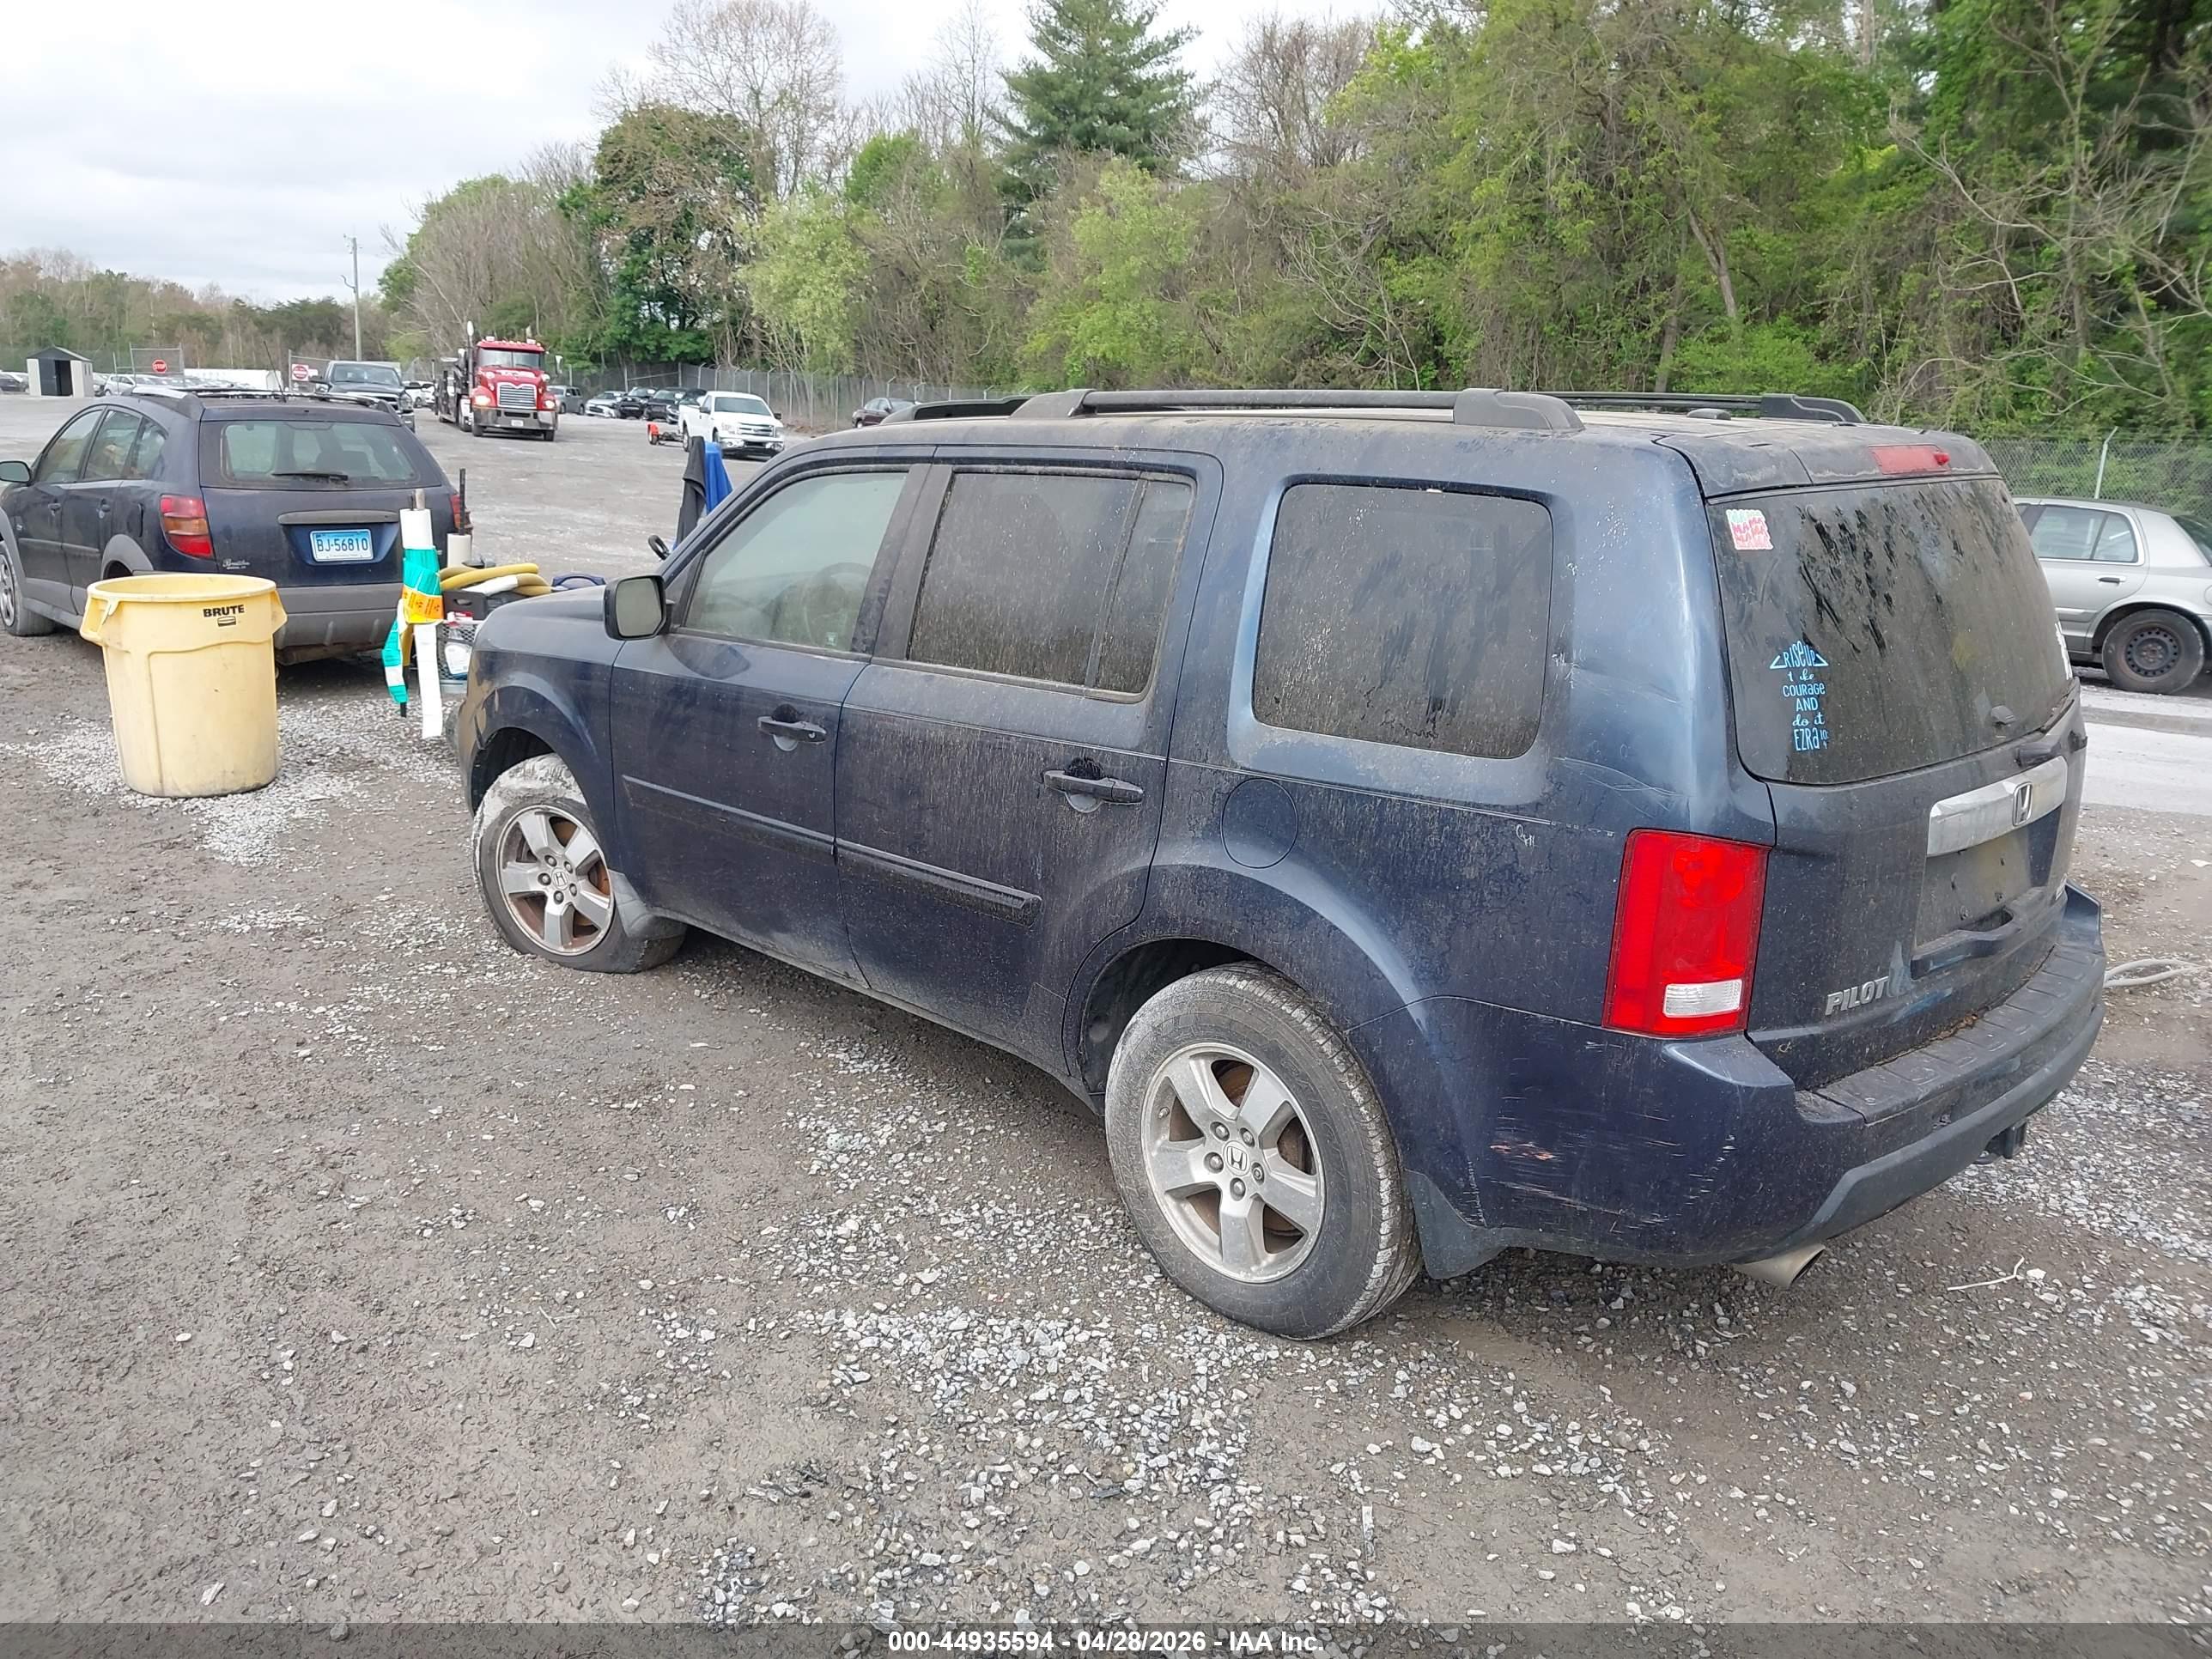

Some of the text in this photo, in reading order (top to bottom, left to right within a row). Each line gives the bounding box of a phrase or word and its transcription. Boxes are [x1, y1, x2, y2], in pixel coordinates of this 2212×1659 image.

[203, 604, 246, 618] BRUTE
[1787, 668, 1814, 682] tke
[1796, 696, 1819, 712] AND
[1792, 711, 1826, 726] do it
[1825, 975, 1889, 1016] PILOT
